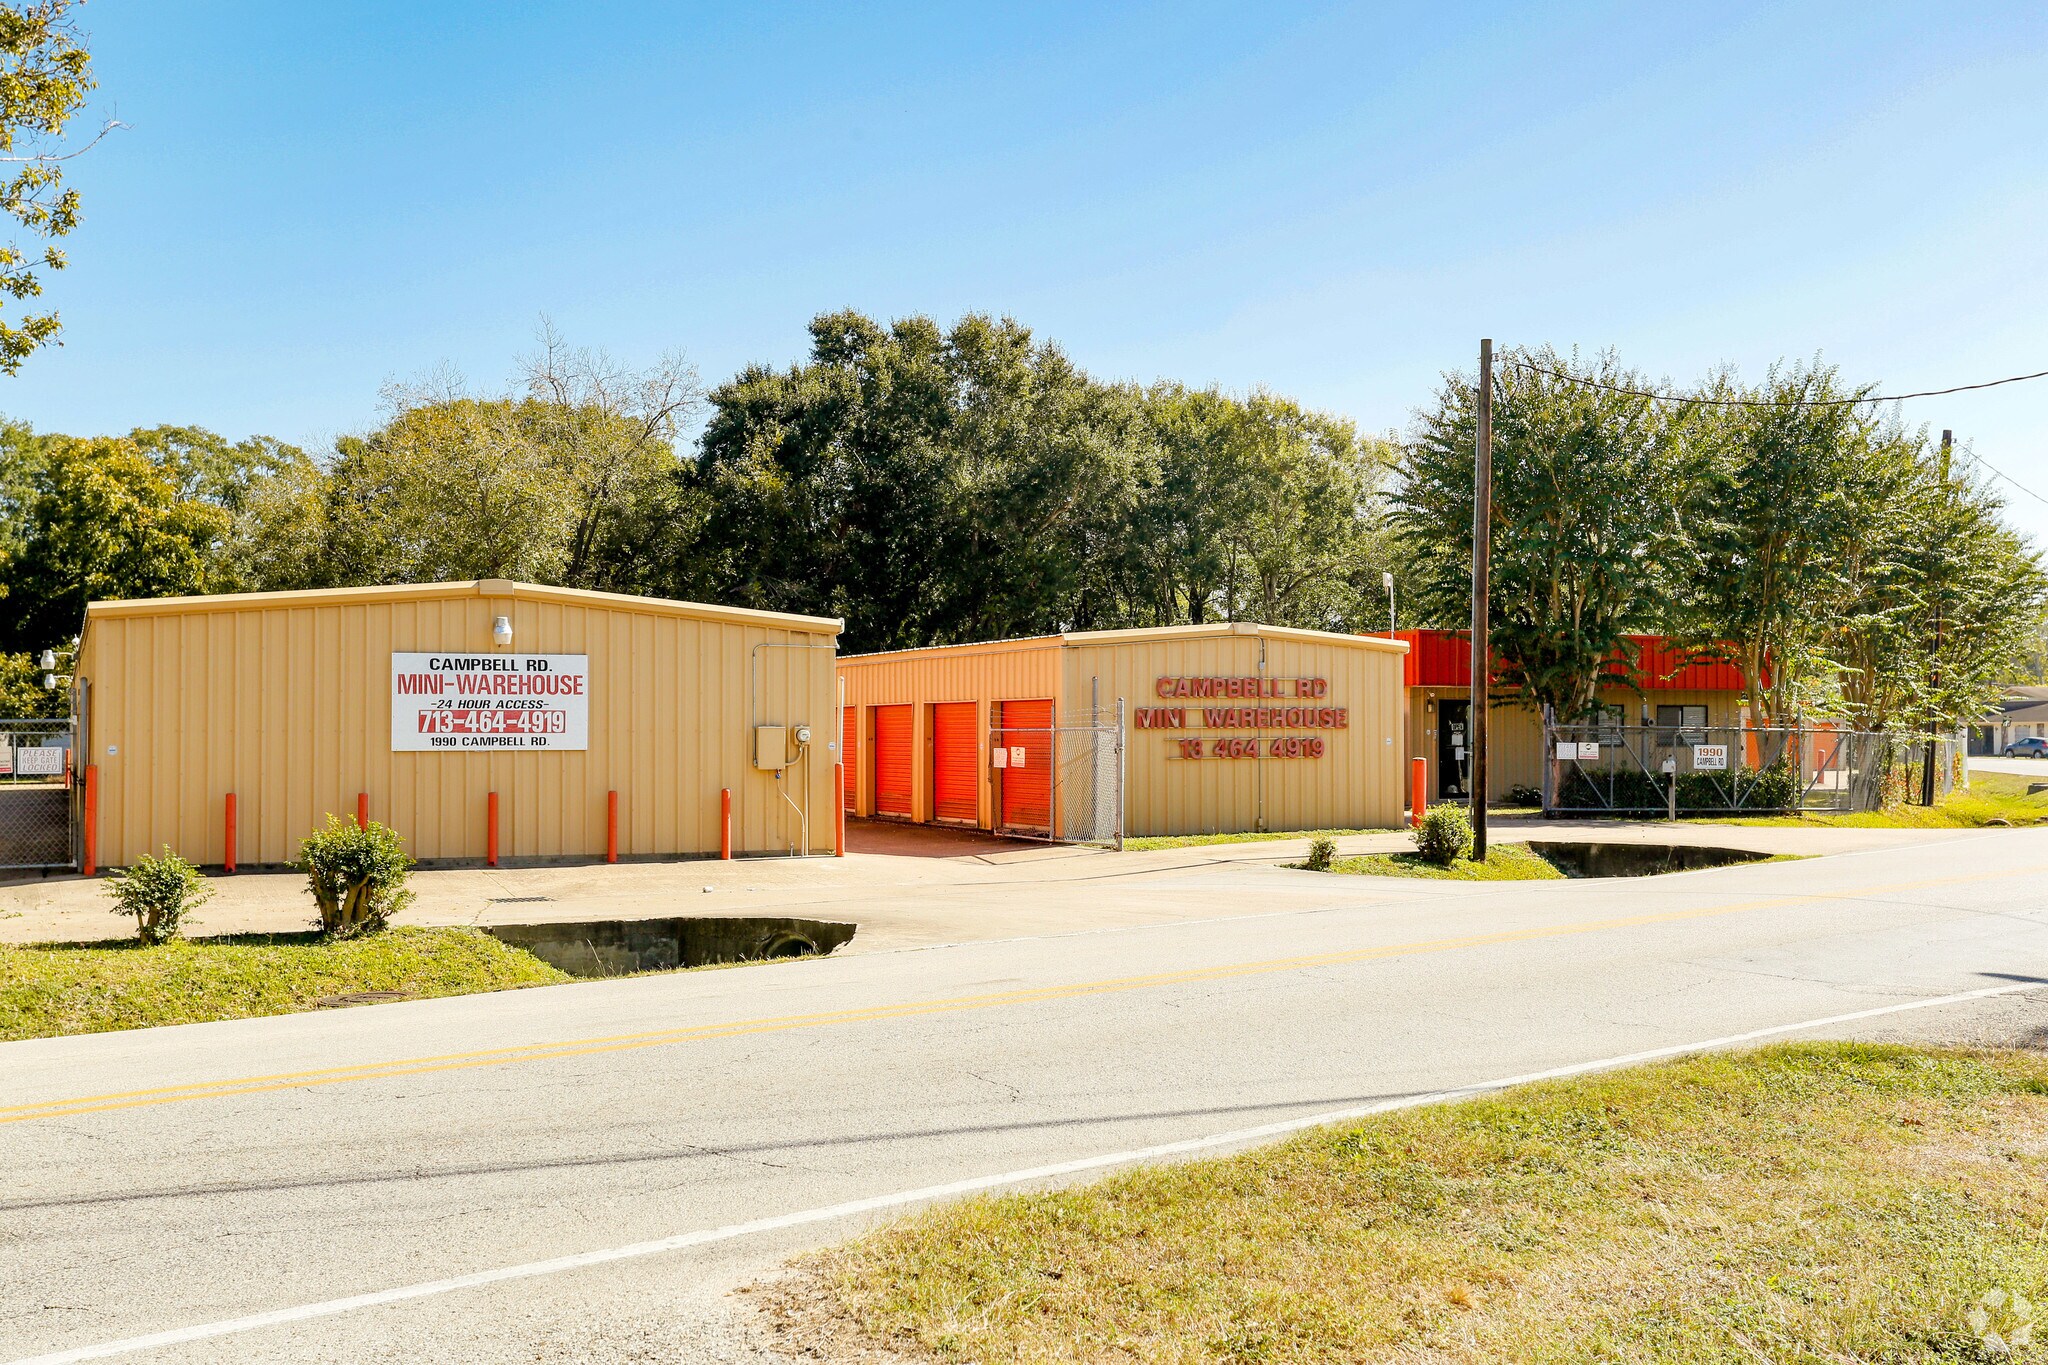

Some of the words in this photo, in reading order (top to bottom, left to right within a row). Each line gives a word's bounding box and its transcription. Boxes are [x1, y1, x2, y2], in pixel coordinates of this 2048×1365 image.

[429, 658, 519, 671] CAMPBELL
[526, 659, 553, 672] RD.
[397, 673, 584, 695] MINI-WAREHOUSE
[1156, 676, 1286, 698] CAMPBELL
[1296, 678, 1328, 698] RD
[458, 700, 491, 709] HOUR
[419, 710, 565, 733] 713-464-4919
[1135, 707, 1187, 729] MINI
[1203, 707, 1348, 729] WAREHOUSE
[430, 737, 457, 747] 1990
[461, 737, 526, 747] CAMPBELL
[530, 737, 551, 747] RD.
[1179, 738, 1204, 759] 13
[1213, 737, 1259, 759] 464
[1270, 737, 1325, 759] 4919
[22, 749, 57, 757] PLEASE
[1698, 748, 1723, 757] 1990
[1696, 757, 1717, 766] CAMPBELL
